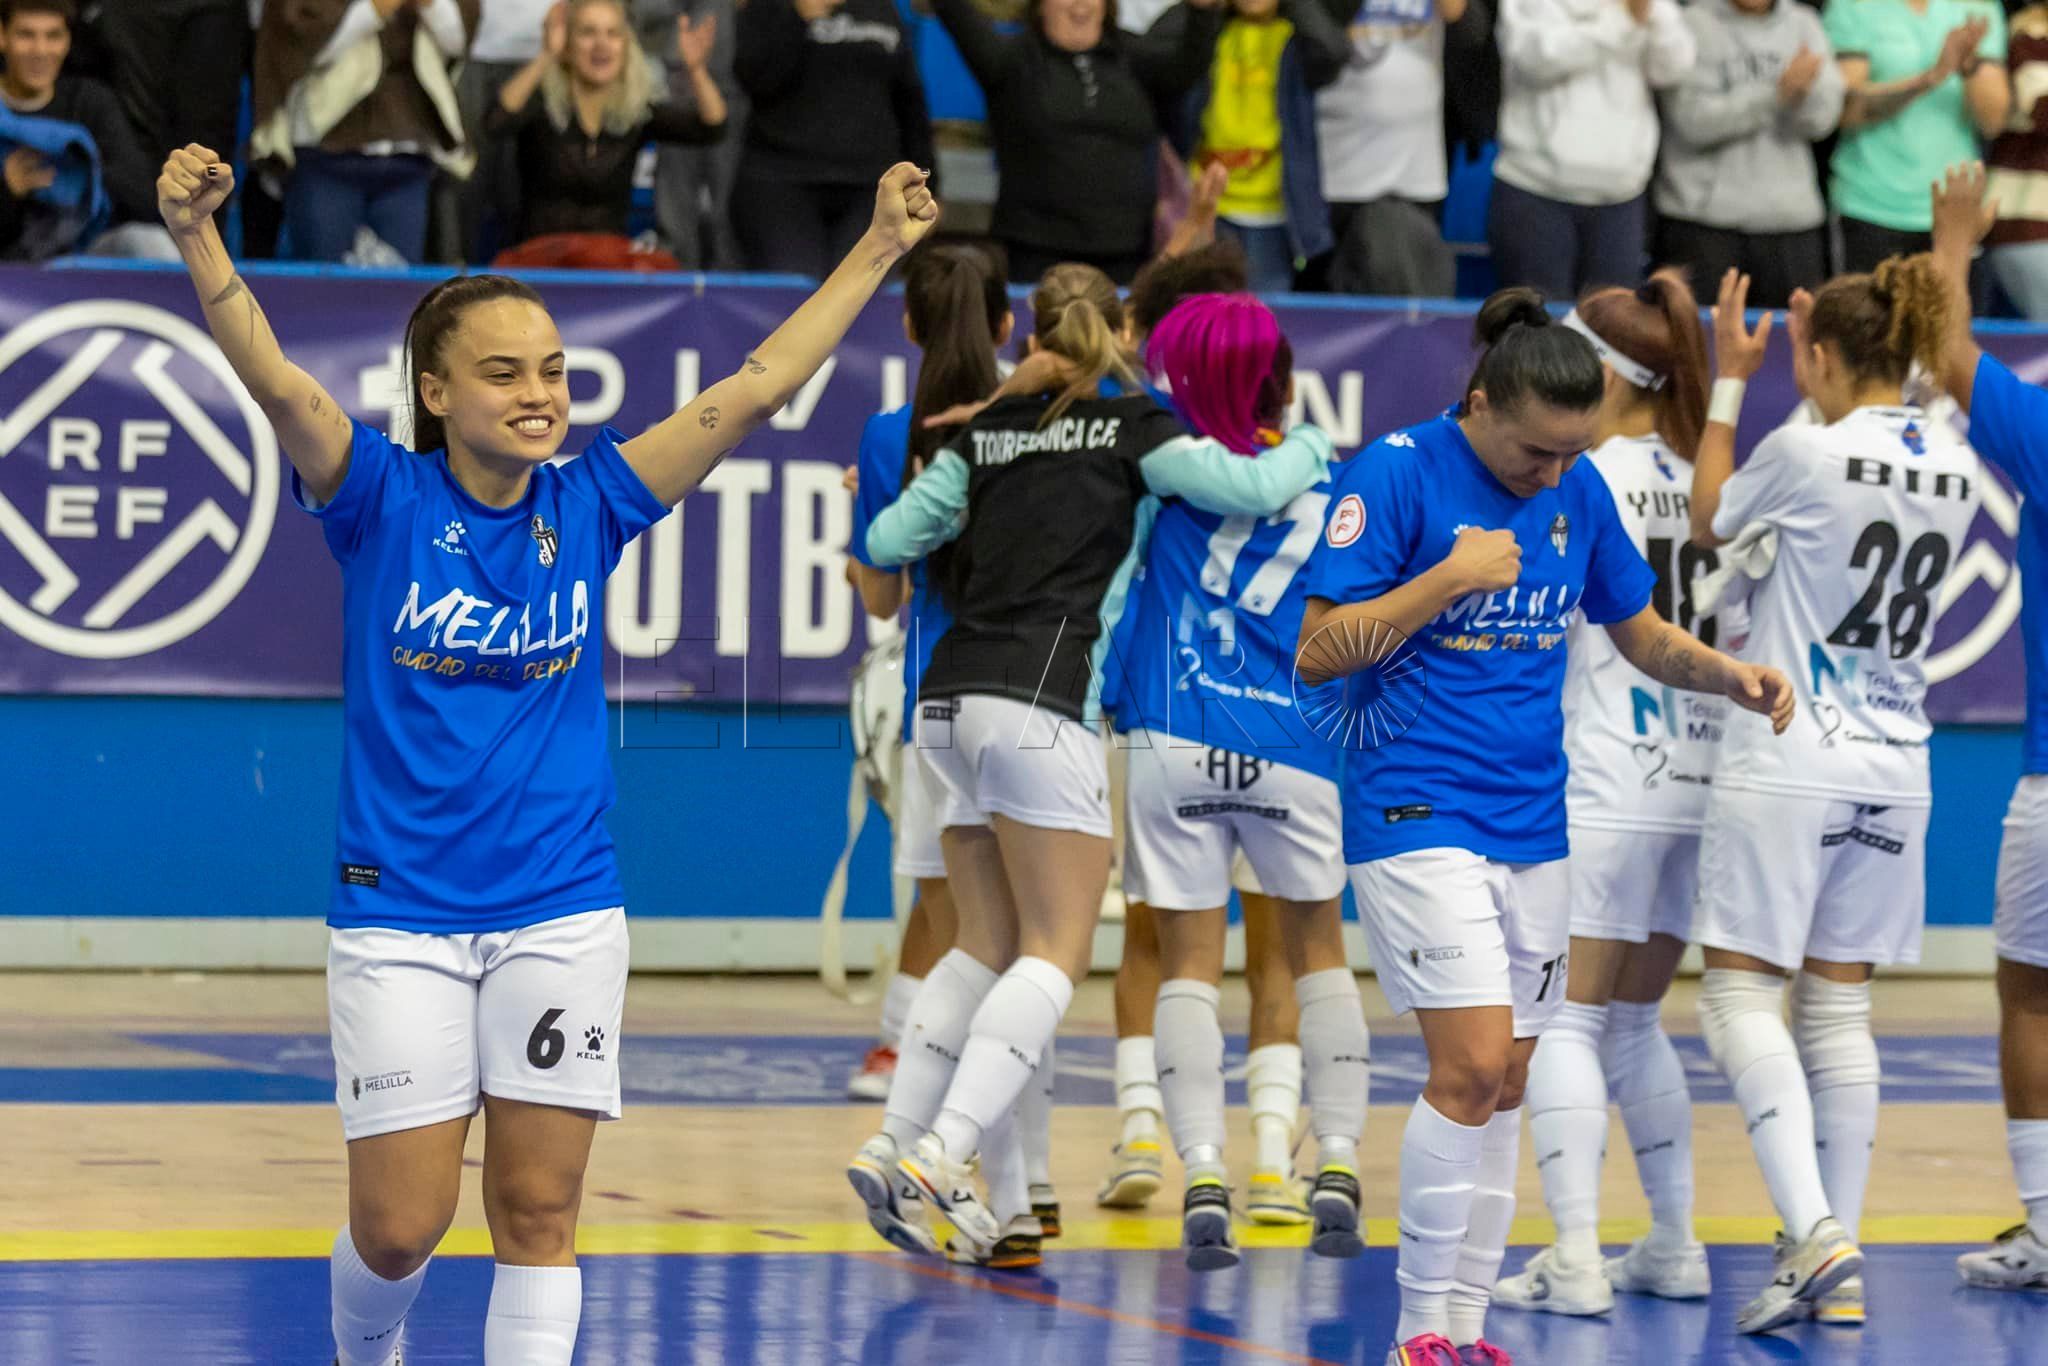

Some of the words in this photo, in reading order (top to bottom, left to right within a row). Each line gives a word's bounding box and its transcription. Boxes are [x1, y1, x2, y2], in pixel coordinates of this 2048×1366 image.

[1826, 520, 1950, 660] 28
[393, 580, 589, 658] MELILLA
[392, 646, 466, 678] CIUDAD
[1424, 950, 1465, 962] MELILLA
[526, 1007, 567, 1070] 6
[576, 1050, 606, 1062] KELME
[365, 1075, 414, 1092] MELILLA
